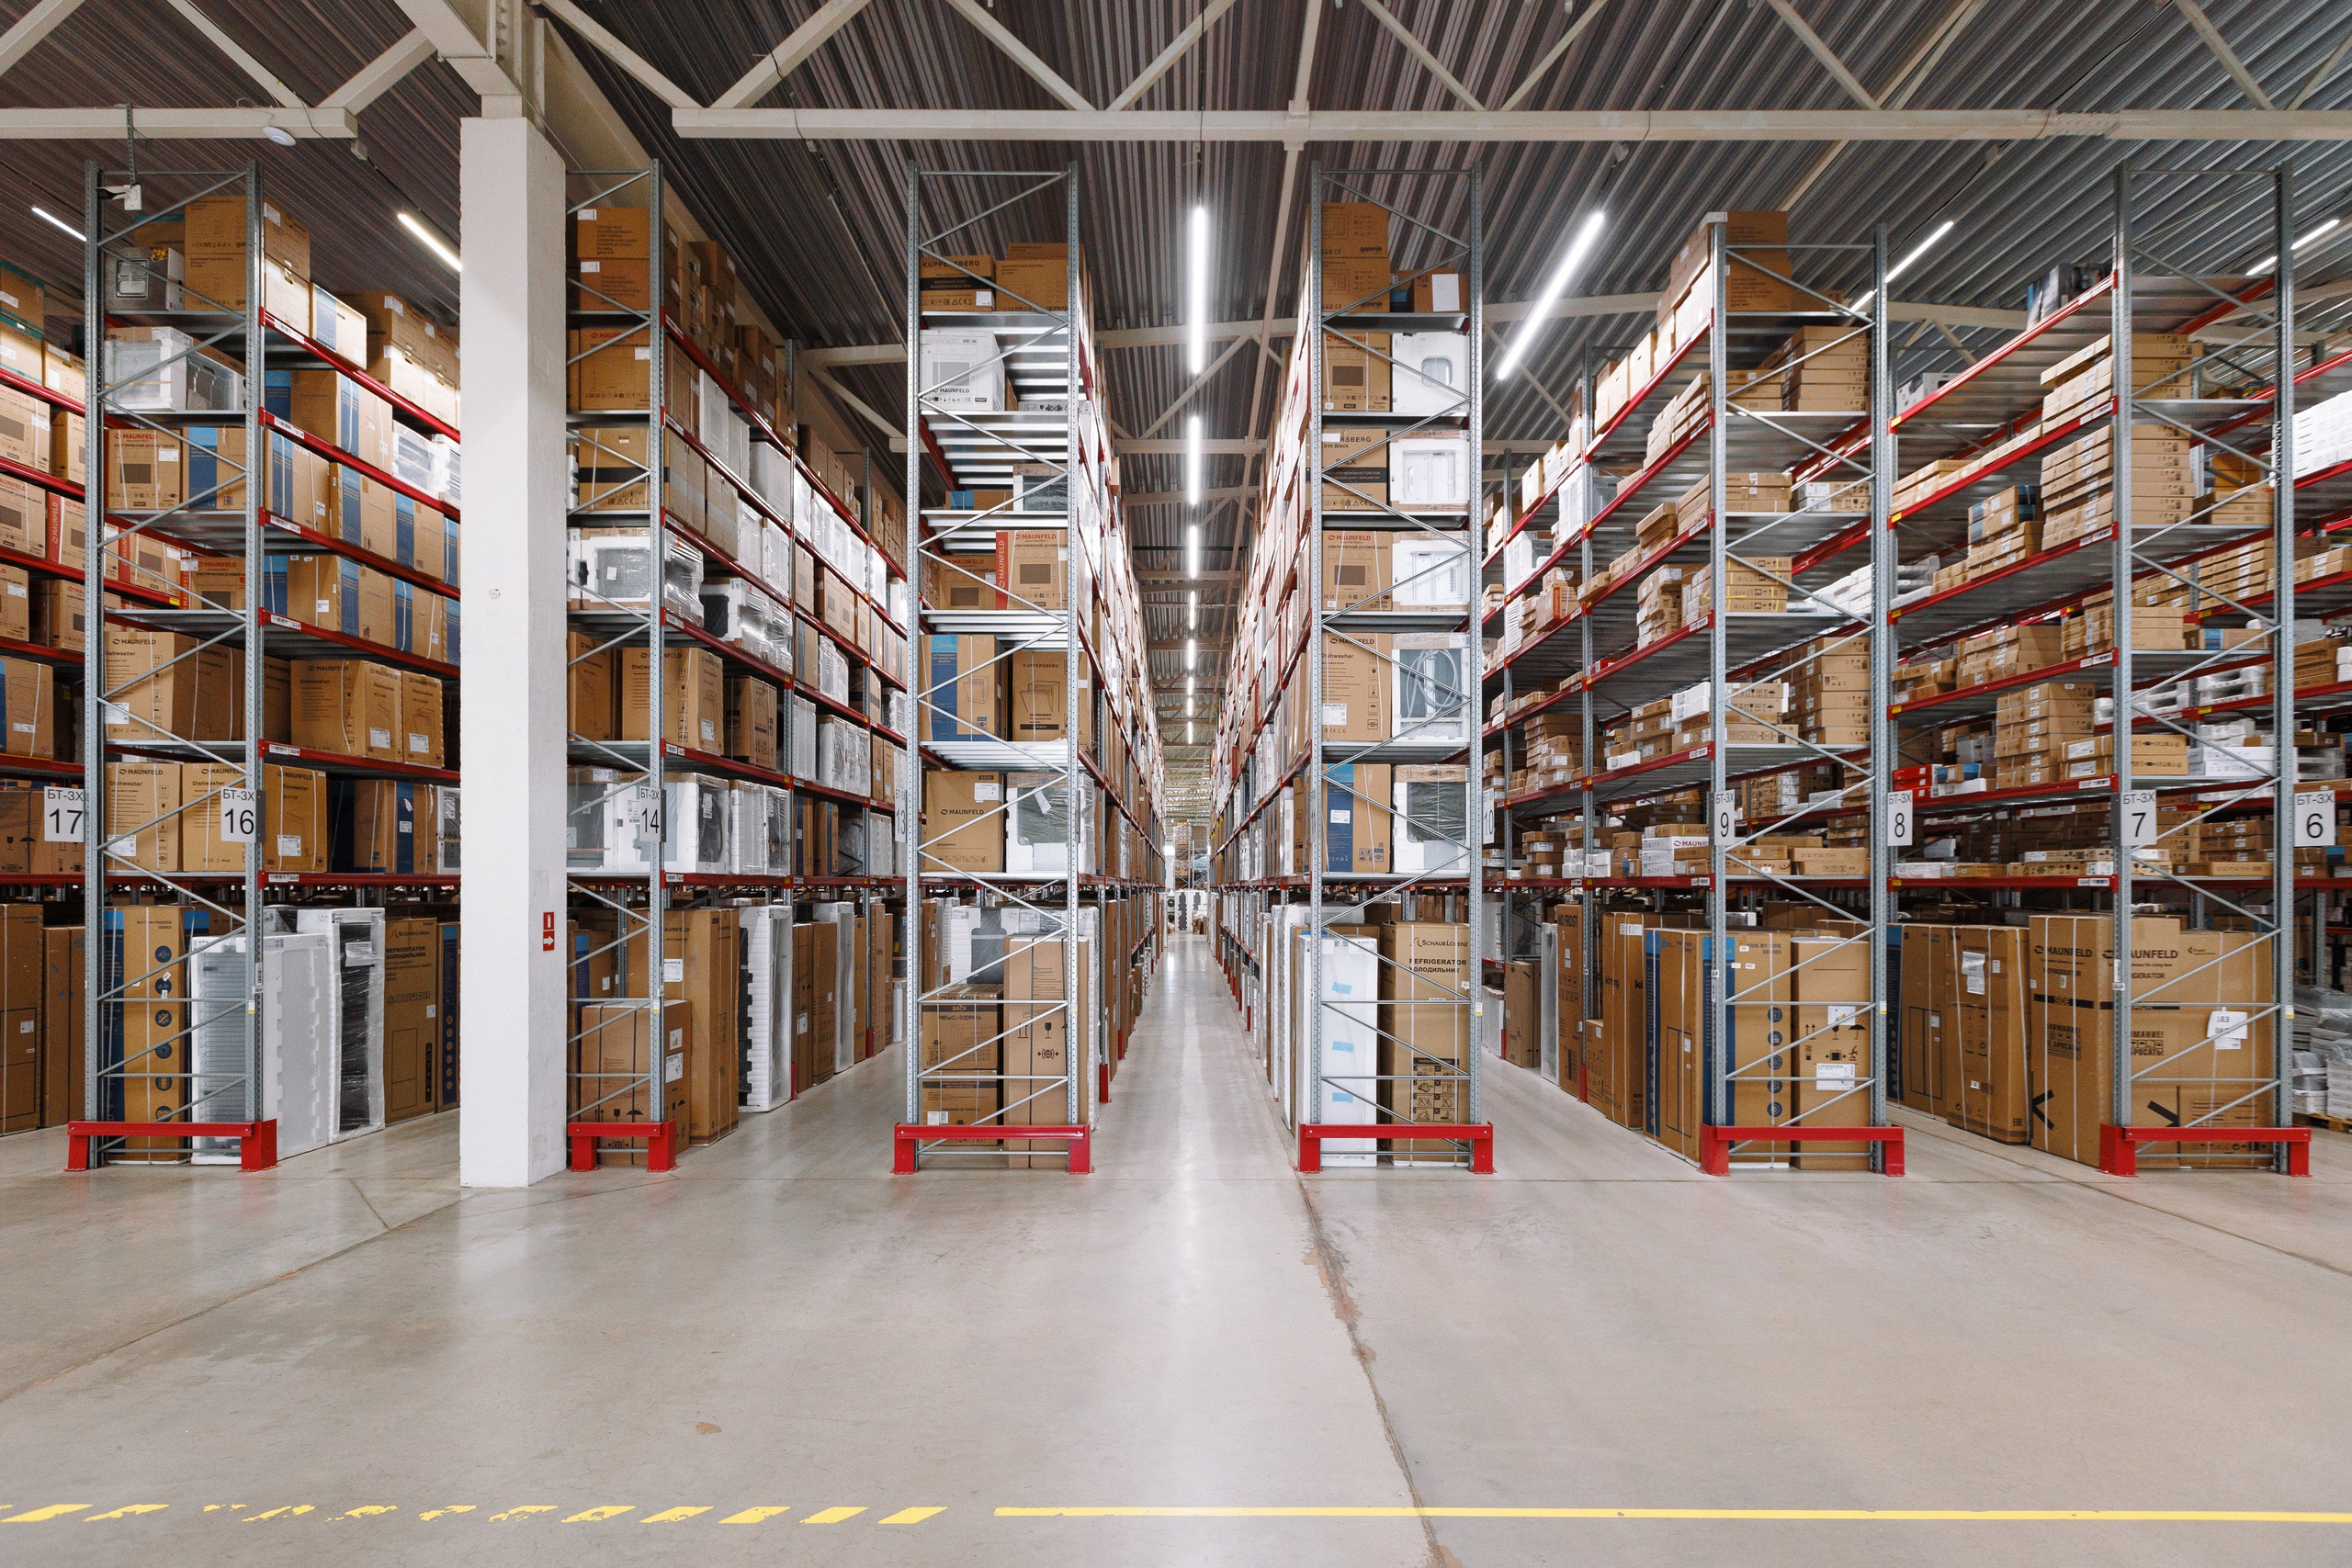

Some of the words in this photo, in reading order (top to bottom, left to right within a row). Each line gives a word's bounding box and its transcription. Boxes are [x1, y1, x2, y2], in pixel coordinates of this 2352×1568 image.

[0, 478, 26, 491] AUNFELD
[50, 808, 83, 834] 17
[225, 808, 254, 835] 16
[642, 807, 659, 833] 14
[896, 809, 906, 835] 13
[1484, 809, 1493, 835] 10
[1720, 812, 1729, 837] 9
[1894, 812, 1905, 838] 8
[2132, 812, 2146, 838] 7
[2306, 813, 2323, 838] 6
[1558, 914, 1565, 926] NO
[1565, 915, 1577, 928] FROST
[2131, 950, 2178, 959] AUNFELD
